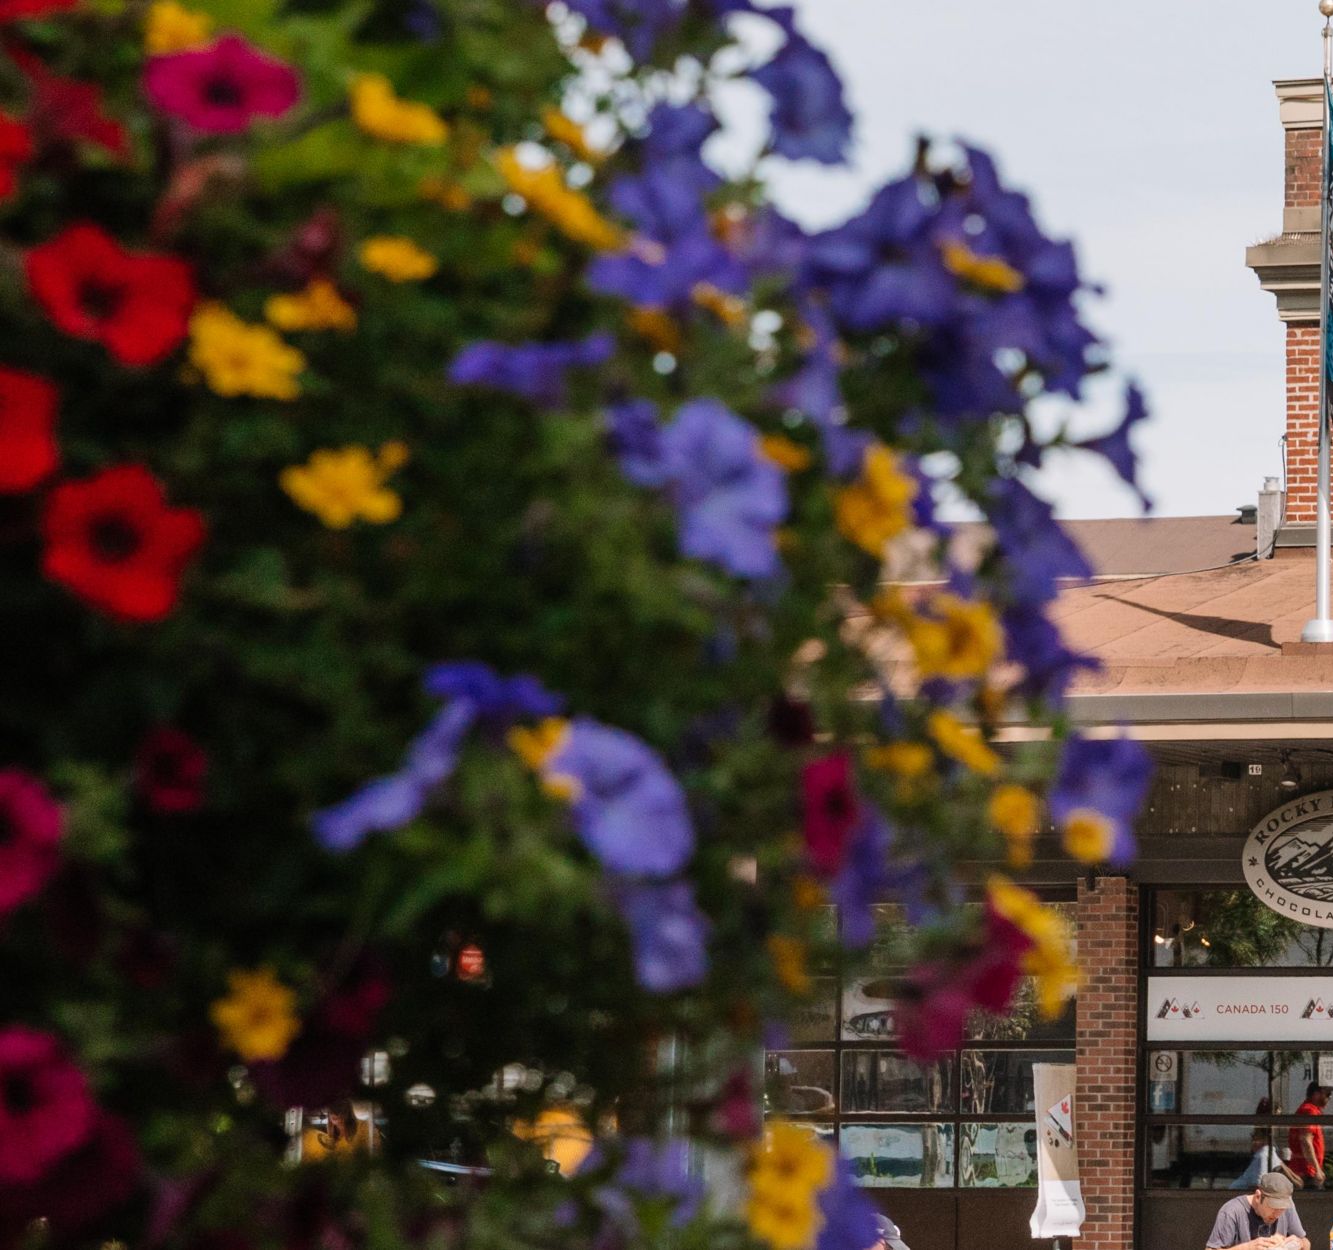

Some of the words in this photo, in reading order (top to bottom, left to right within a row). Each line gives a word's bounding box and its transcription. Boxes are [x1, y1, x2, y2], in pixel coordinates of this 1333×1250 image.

[1254, 798, 1322, 846] ROCKY
[1216, 1004, 1266, 1015] CANADA
[1270, 1004, 1289, 1015] 150
